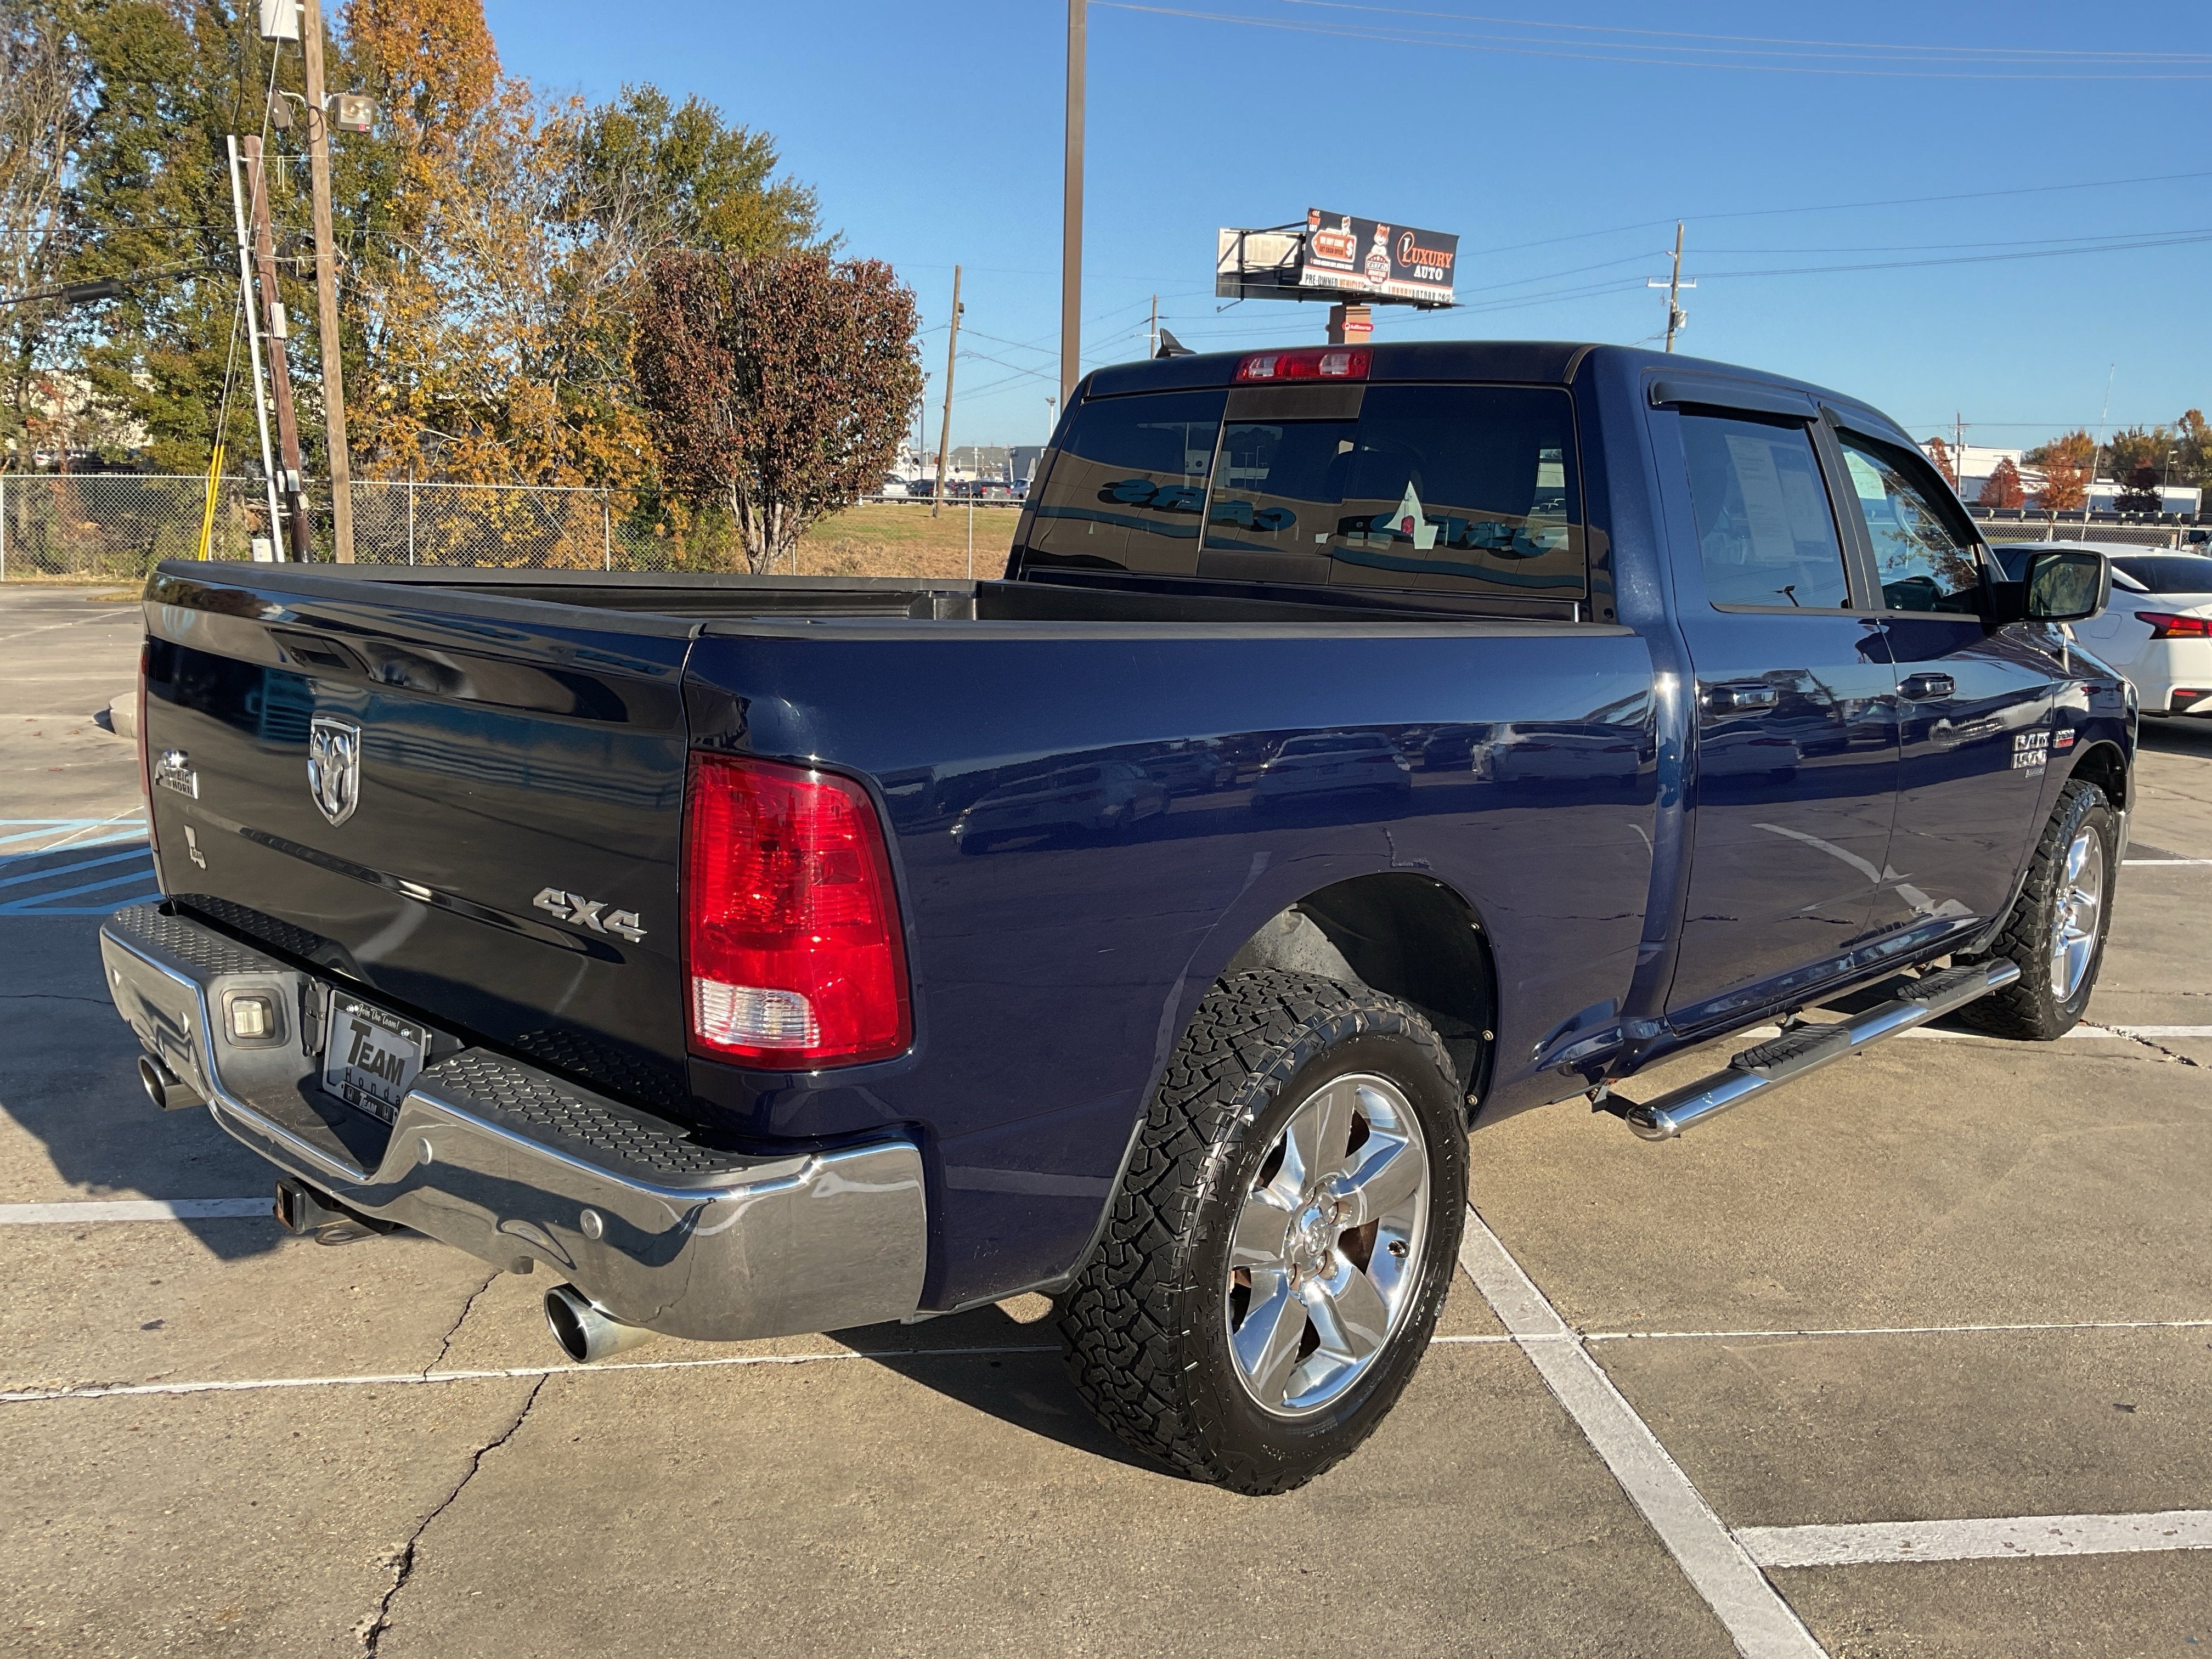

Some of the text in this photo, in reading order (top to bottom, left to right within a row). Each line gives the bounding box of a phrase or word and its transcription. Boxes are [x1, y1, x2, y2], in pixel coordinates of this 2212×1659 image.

[1398, 233, 1453, 268] LUXURY
[1305, 273, 1364, 290] PRE-OWNED VEHICLES
[1414, 266, 1443, 281] AUTO
[2013, 732, 2050, 751] RAM
[2011, 749, 2047, 769] 1500
[177, 771, 189, 783] BIG
[171, 780, 193, 795] HORN
[357, 1003, 400, 1030] Join The Team!
[347, 1019, 405, 1087] TEAM
[345, 1066, 401, 1106] Honda
[359, 1092, 377, 1114] TEAM
